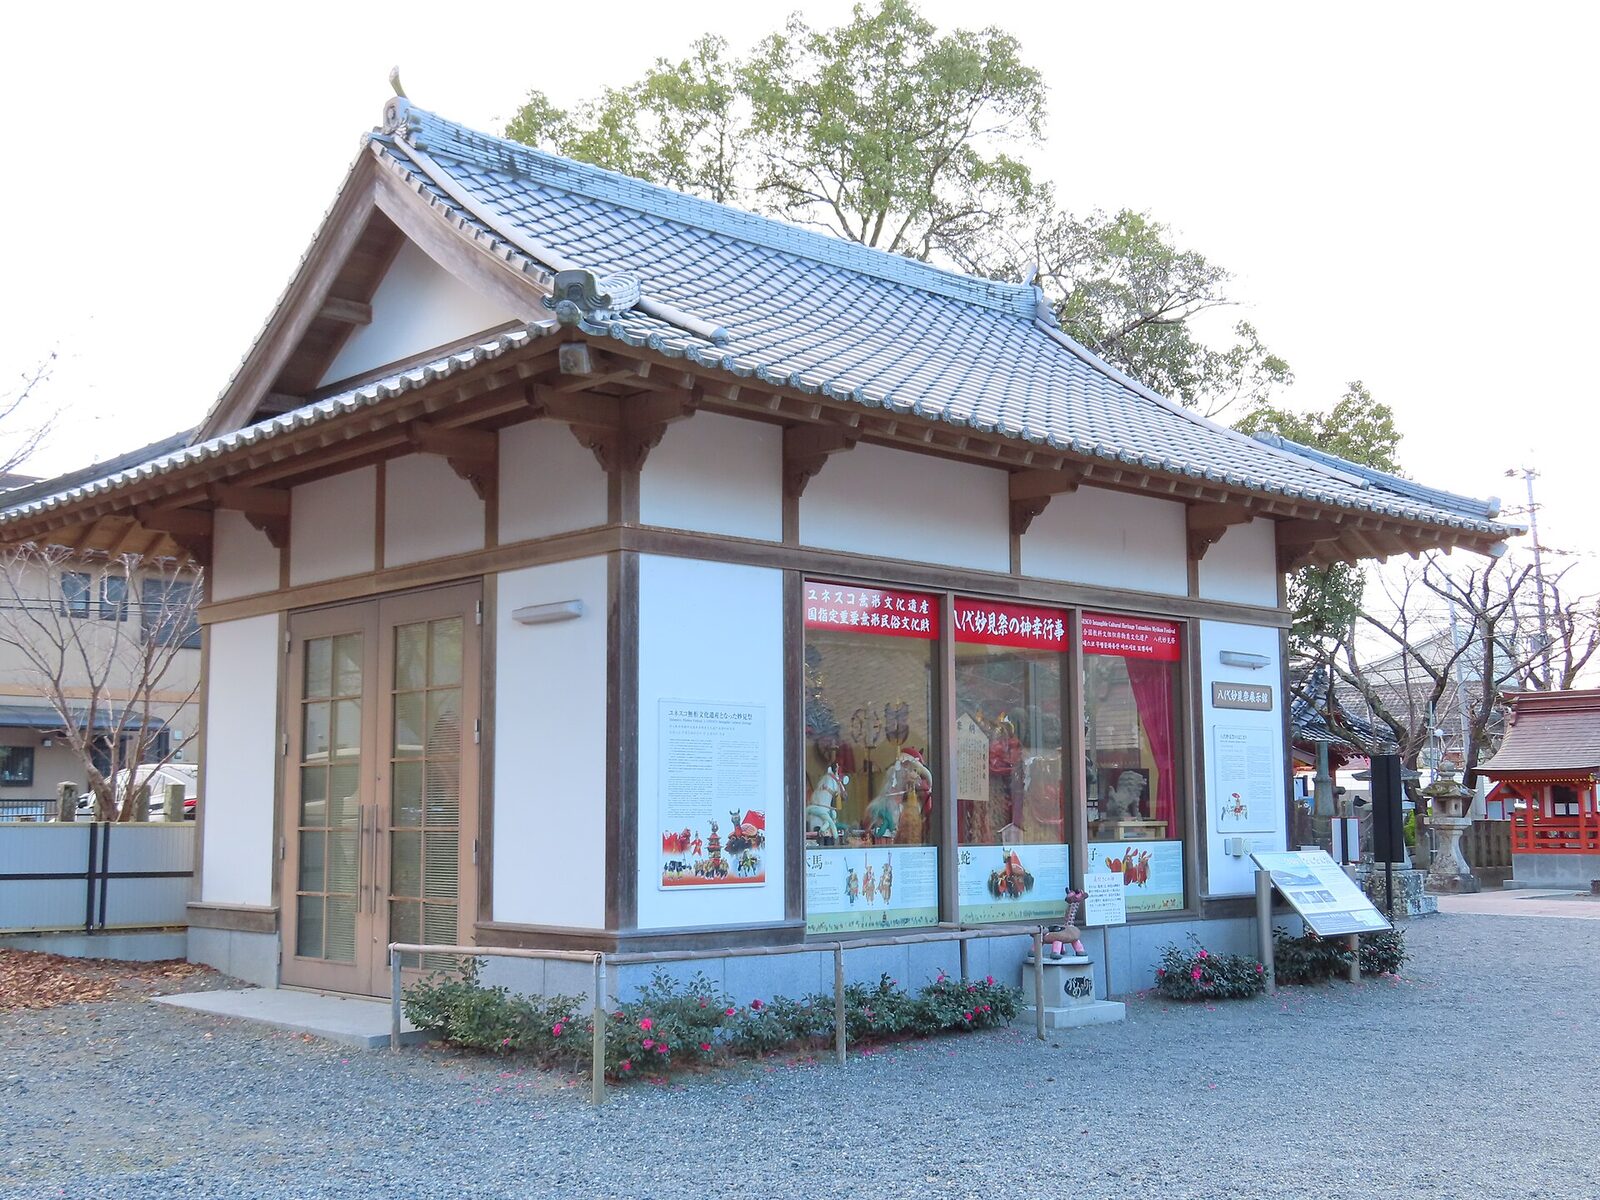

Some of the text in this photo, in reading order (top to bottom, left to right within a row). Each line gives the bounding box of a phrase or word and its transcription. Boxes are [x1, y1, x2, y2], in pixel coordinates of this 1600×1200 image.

[808, 589, 929, 614] ユネスコ無形文化遺産
[808, 607, 930, 632] 国指定重要無形民俗文化財
[958, 850, 971, 865] 蛇
